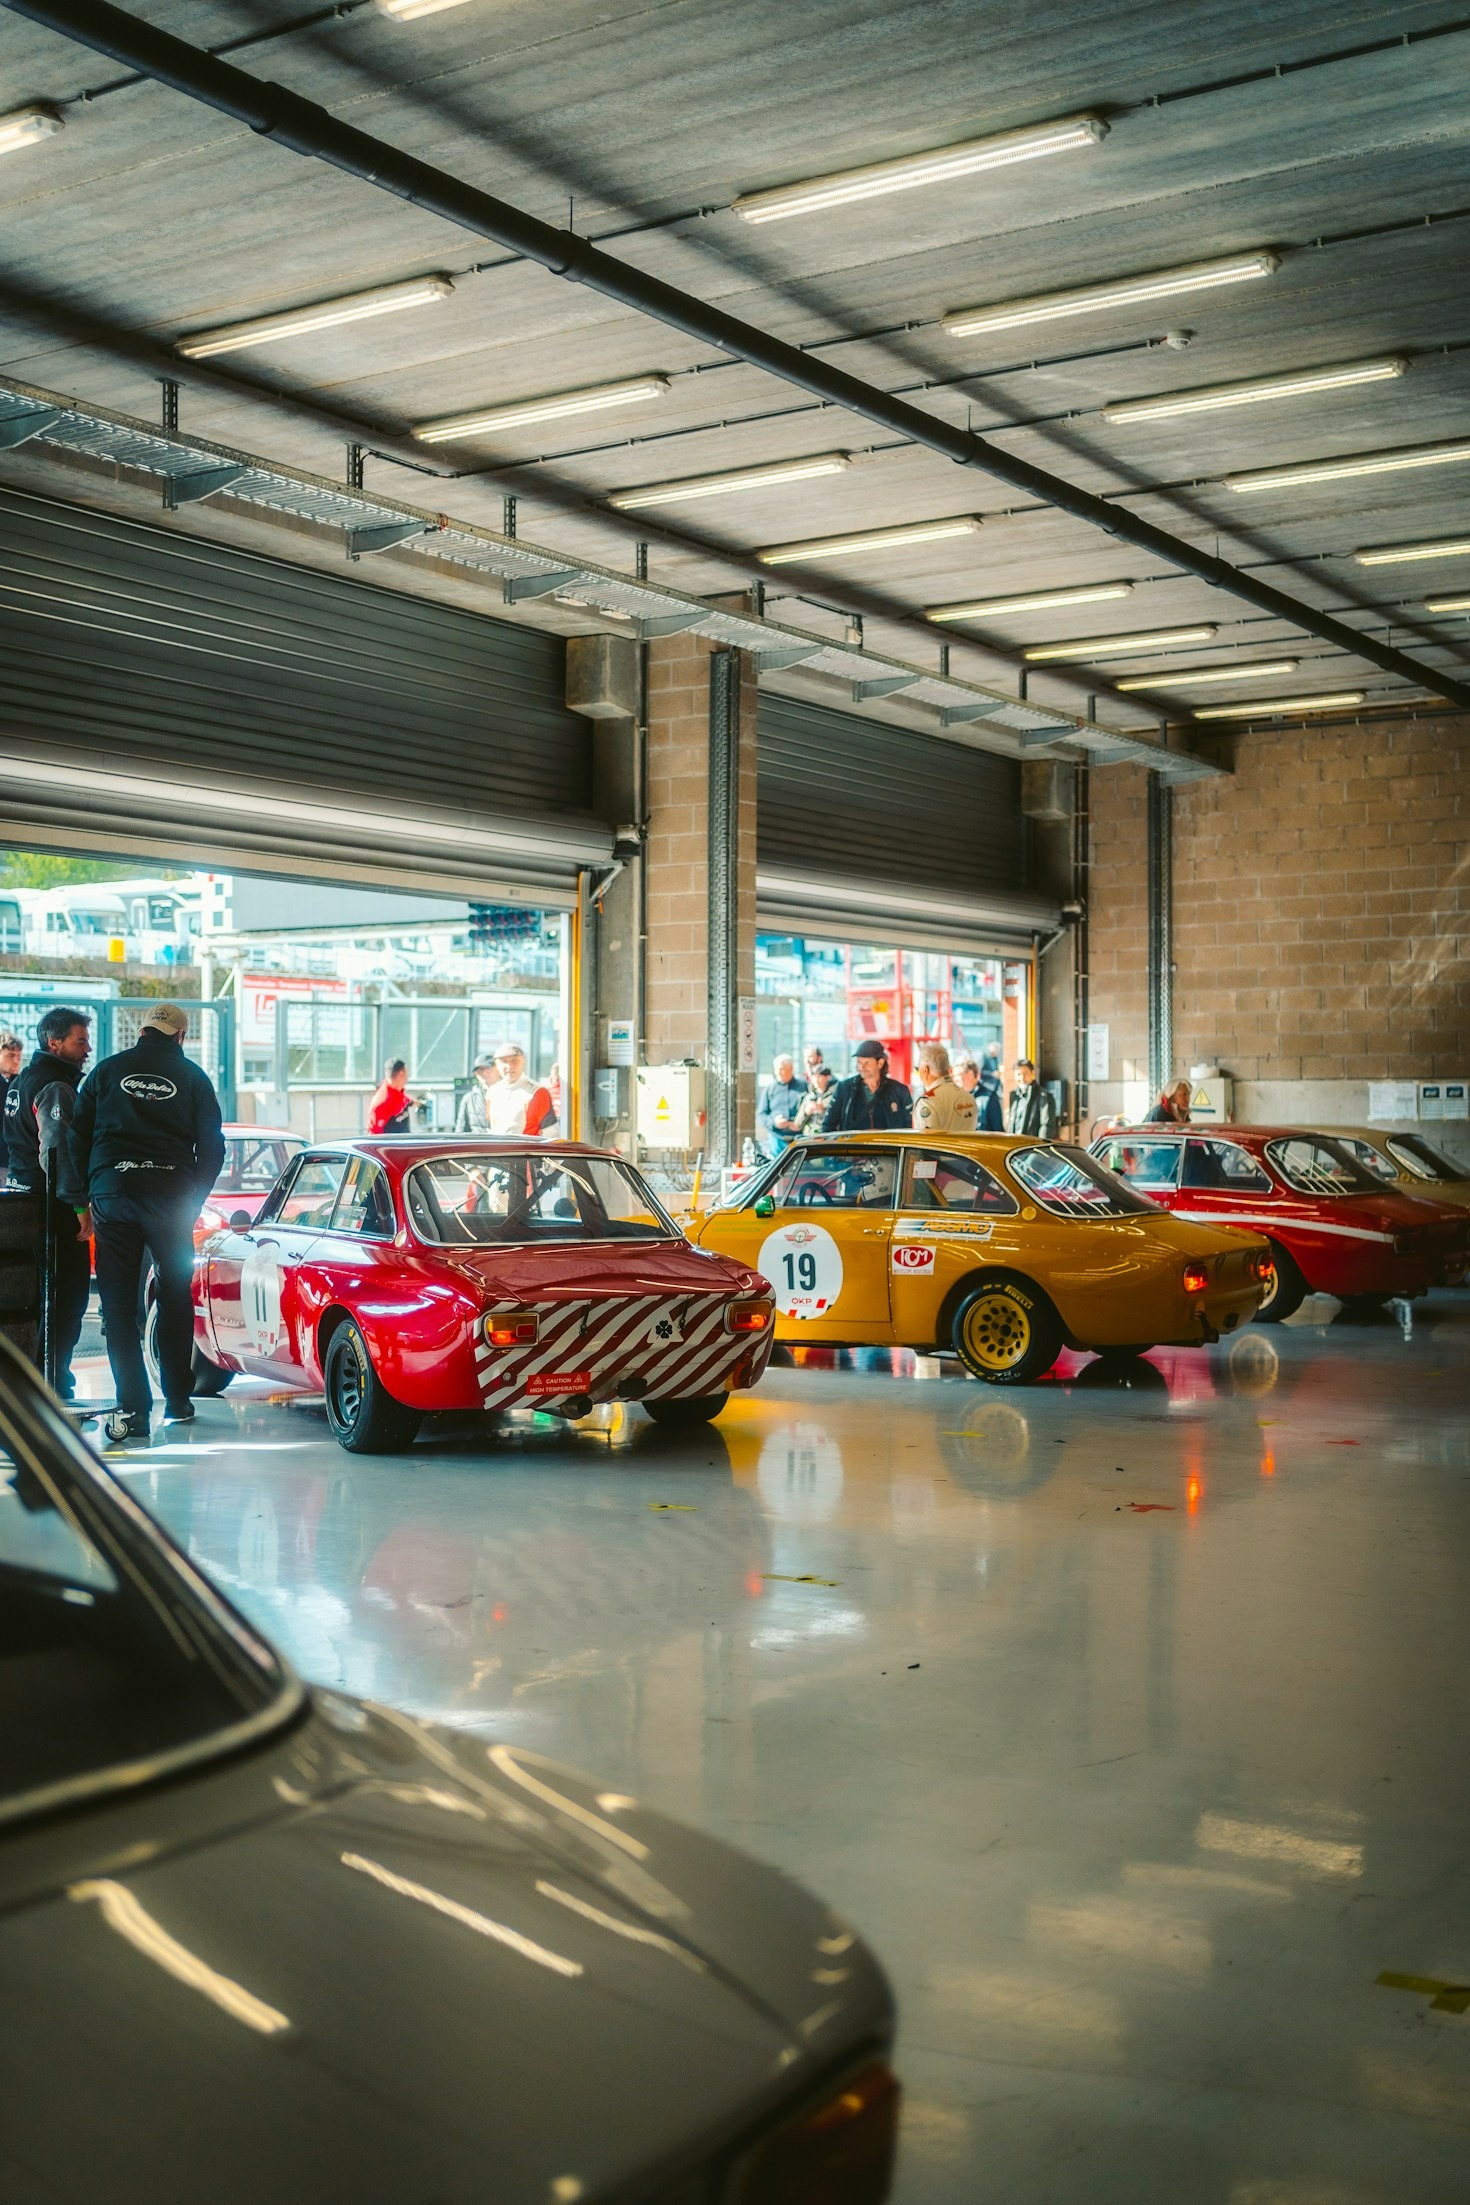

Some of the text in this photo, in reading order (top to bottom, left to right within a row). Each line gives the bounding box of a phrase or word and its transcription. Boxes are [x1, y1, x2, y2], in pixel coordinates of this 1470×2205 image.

[124, 1079, 147, 1089] Alfa
[782, 1252, 817, 1291] 19
[252, 1277, 267, 1323] 11
[791, 1297, 813, 1305] OKP
[1003, 1284, 1034, 1311] PIRELLI
[545, 1377, 572, 1385] CAUTION
[545, 1384, 588, 1393] TEMPERATURE
